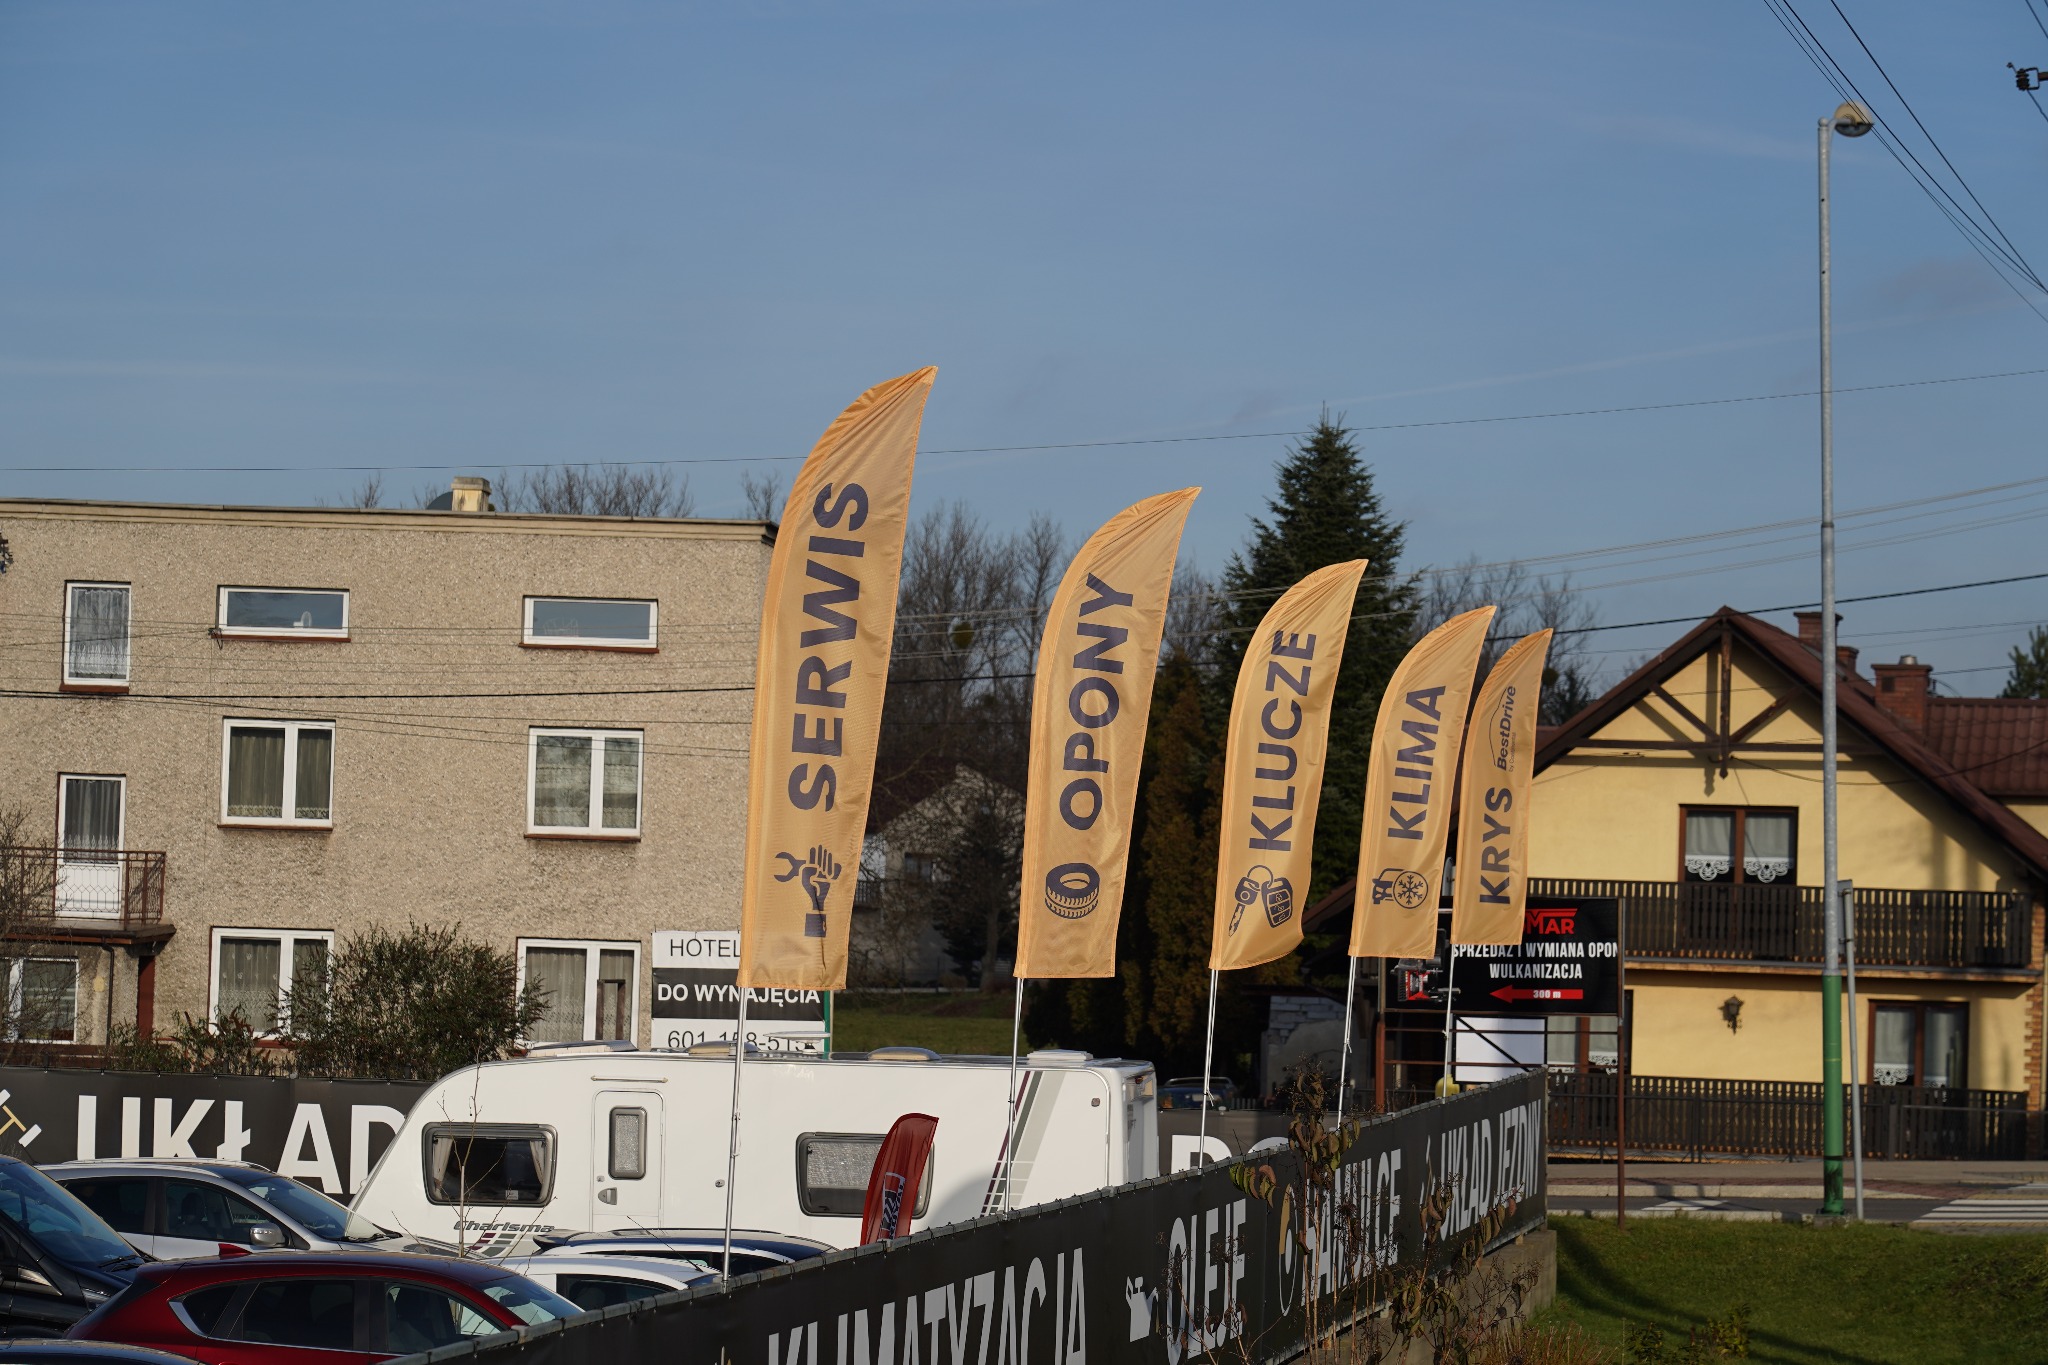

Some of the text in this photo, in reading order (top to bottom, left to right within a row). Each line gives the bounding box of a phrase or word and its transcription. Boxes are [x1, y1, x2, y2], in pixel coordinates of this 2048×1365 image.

[788, 482, 869, 812] SERWIS
[1059, 572, 1134, 831] OPONY
[1248, 629, 1317, 851] KLUCZE
[1497, 685, 1517, 771] BestDrive
[1387, 685, 1447, 841] KLIMA
[1479, 787, 1513, 905] KRYS
[1523, 908, 1577, 935] MAR
[669, 938, 740, 958] HOTEL
[1525, 942, 1585, 958] WYMIANA
[1489, 963, 1583, 979] WULKANIZACJA
[657, 983, 688, 1001] DO
[1533, 989, 1561, 999] 300 m
[453, 1220, 555, 1233] Charisma
